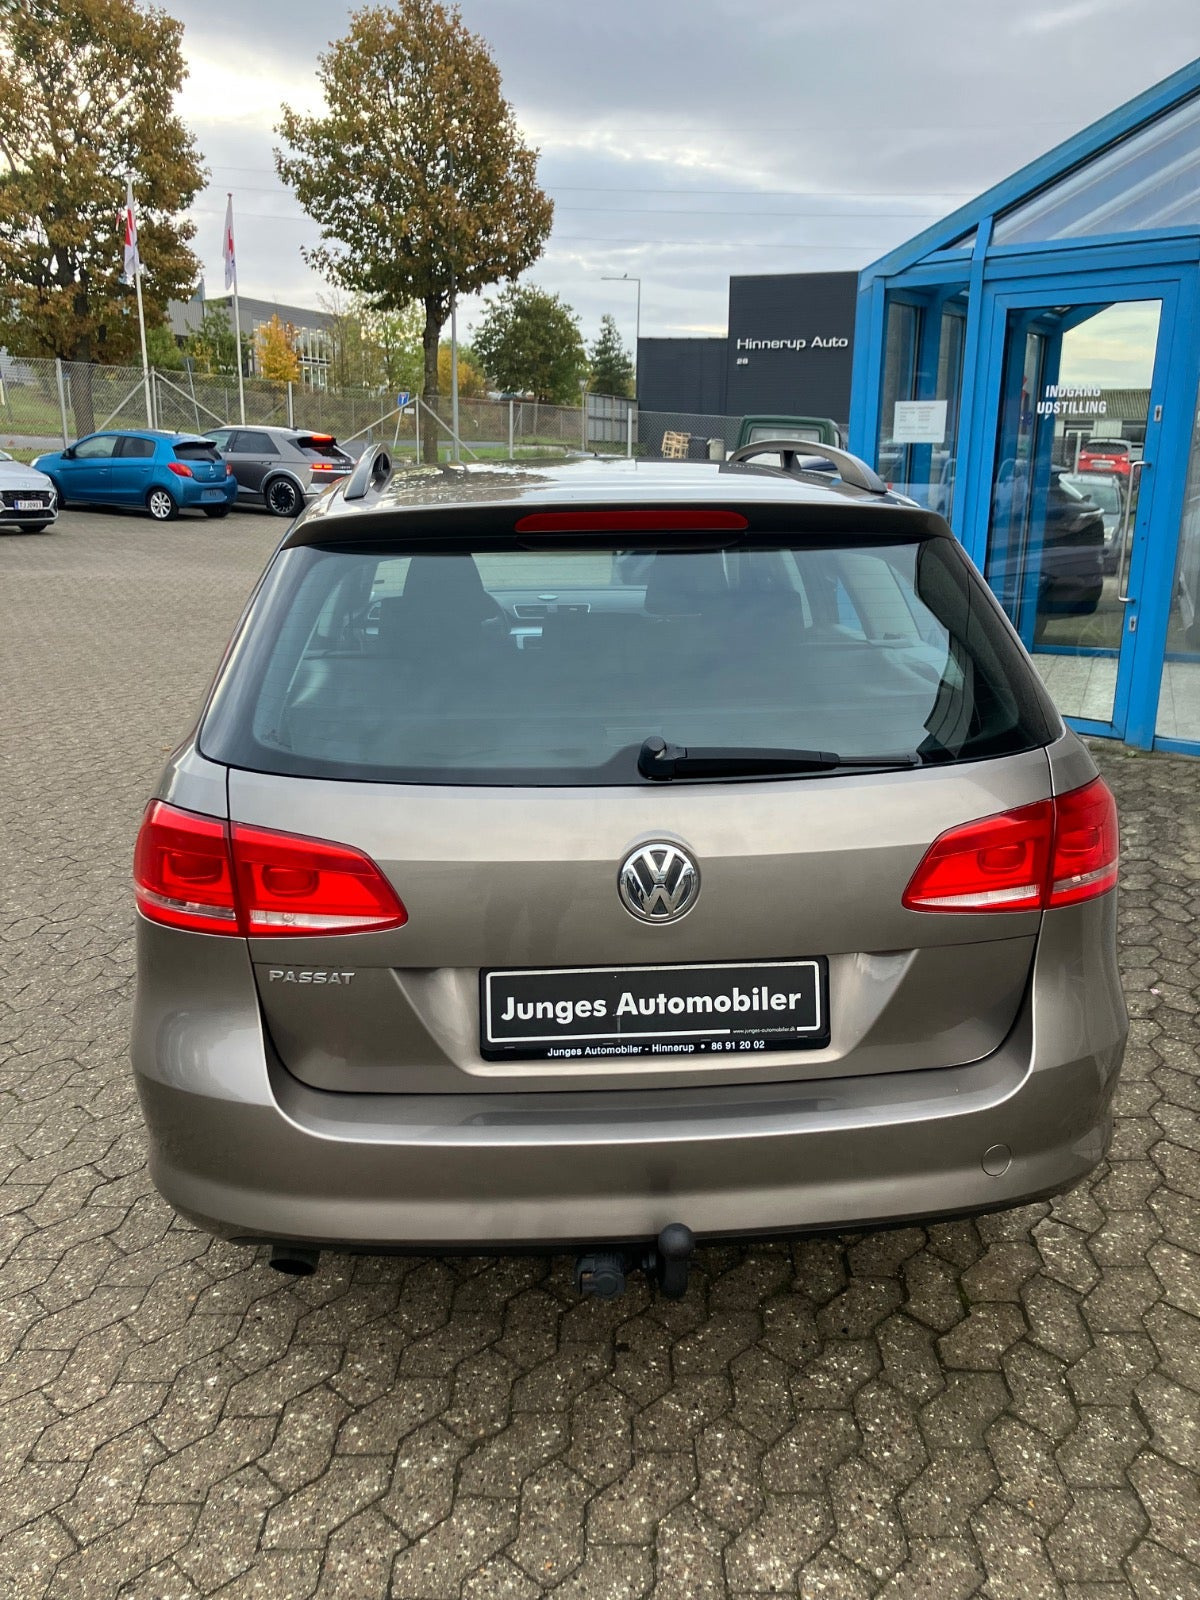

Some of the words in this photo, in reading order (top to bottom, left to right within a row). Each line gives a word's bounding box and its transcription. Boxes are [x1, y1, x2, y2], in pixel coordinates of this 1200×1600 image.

[736, 338, 806, 351] Hinnerup
[811, 335, 849, 349] Auto
[1045, 384, 1101, 398] INDGANG
[1036, 400, 1107, 414] UDSTILLING
[269, 970, 355, 985] PASSAT
[501, 996, 607, 1025] Junges
[616, 986, 802, 1017] Automobiler
[547, 1047, 582, 1057] Junges
[584, 1044, 643, 1054] Automobiler
[651, 1043, 695, 1053] Hinnerup
[711, 1041, 723, 1051] 86
[725, 1041, 736, 1050] 91
[739, 1040, 751, 1050] 20
[753, 1040, 765, 1049] 02
